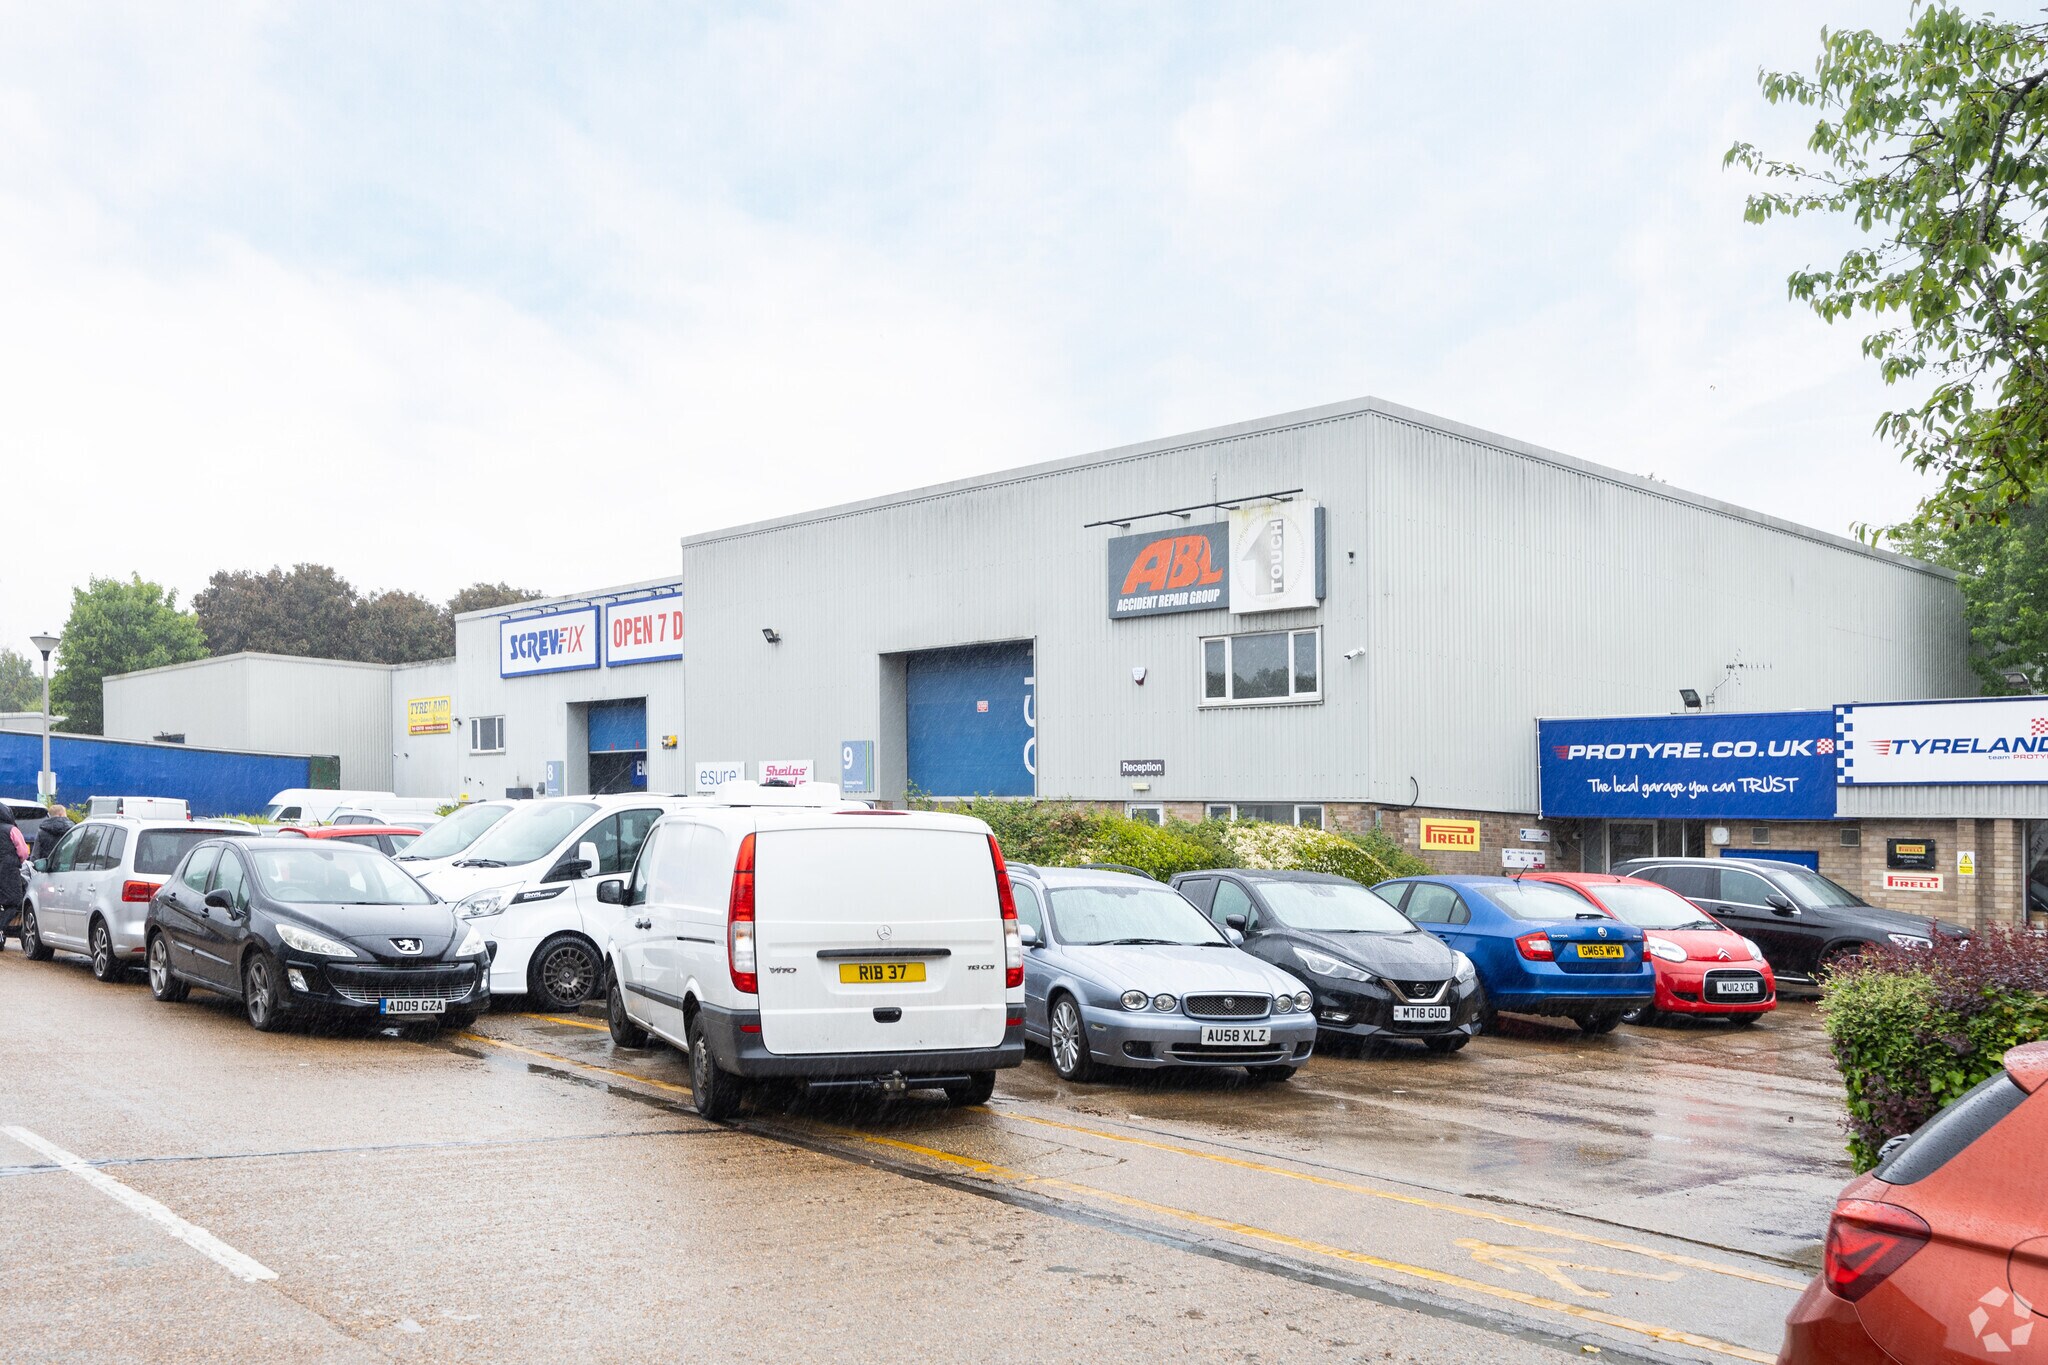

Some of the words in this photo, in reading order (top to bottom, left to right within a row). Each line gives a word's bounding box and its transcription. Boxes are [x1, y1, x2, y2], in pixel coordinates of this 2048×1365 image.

[1121, 534, 1223, 595] ABL
[1270, 519, 1284, 593] TOUCH
[1117, 594, 1158, 612] ACCIDENT
[1158, 592, 1189, 607] REPAIR
[1189, 589, 1220, 605] GROUP
[613, 614, 652, 648] OPEN
[657, 613, 667, 642] 7
[510, 624, 585, 663] SCREWFIX
[410, 699, 449, 715] TYRELAND
[843, 746, 853, 770] 9
[1567, 739, 1814, 760] PROTYRE.CO.UK
[547, 764, 554, 781] 8
[1122, 761, 1162, 773] Reception
[700, 767, 737, 786] esure
[1587, 778, 1612, 794] The
[1613, 775, 1639, 793] local
[1642, 781, 1686, 799] garage
[1688, 781, 1709, 800] you
[1711, 781, 1736, 793] can
[1737, 774, 1800, 793] TRUST
[1425, 824, 1475, 845] PIRELLI
[1887, 875, 1940, 889] PIRELLI
[1581, 945, 1604, 957] GM65
[1605, 945, 1621, 957] WPW
[859, 964, 884, 981] RIB
[888, 964, 907, 980] 37
[1722, 982, 1739, 992] WU12
[1740, 982, 1754, 992] XCR
[389, 1000, 419, 1012] AD09
[421, 1000, 443, 1011] GZA
[1402, 1007, 1426, 1019] MT18
[1428, 1007, 1447, 1019] GUO
[1207, 1029, 1240, 1043] AU58
[1243, 1029, 1266, 1043] XLZ
